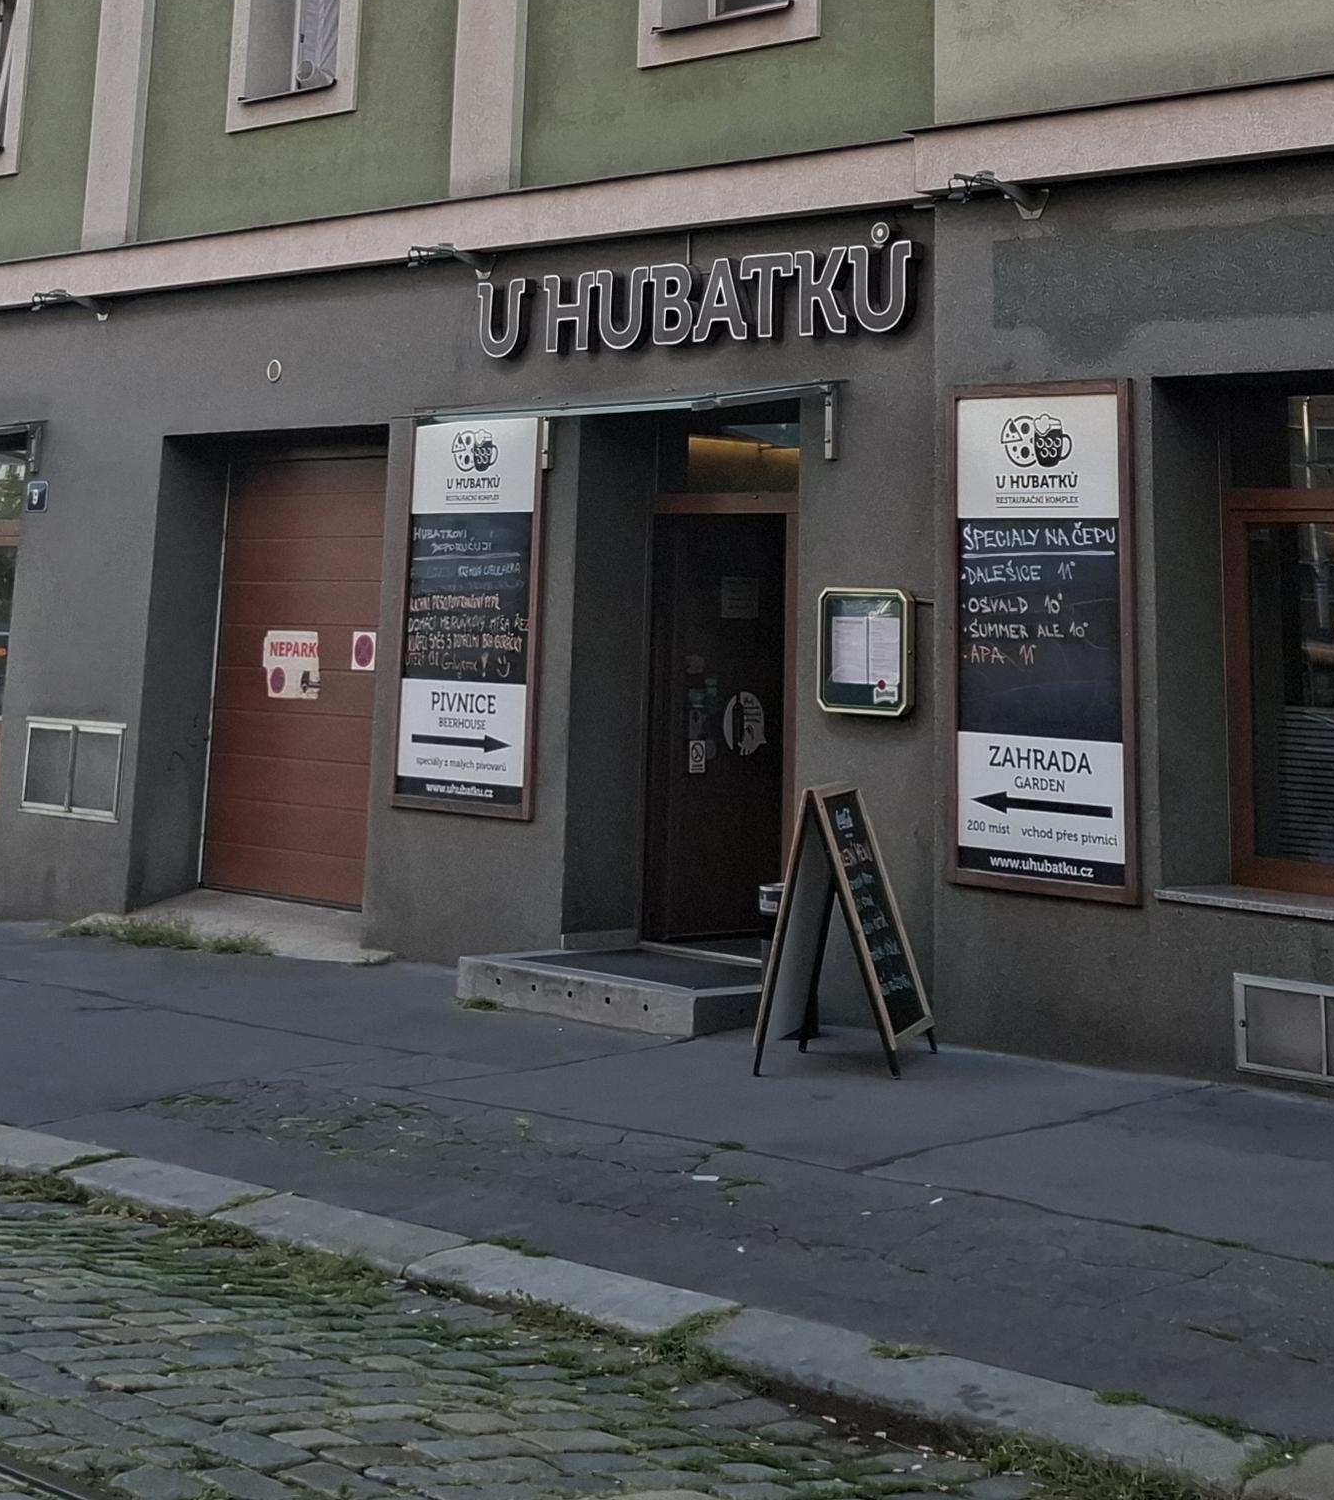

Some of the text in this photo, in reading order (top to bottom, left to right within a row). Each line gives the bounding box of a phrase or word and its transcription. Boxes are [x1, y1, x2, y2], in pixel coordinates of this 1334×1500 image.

[476, 221, 917, 359] U HUBATKŮ
[447, 474, 501, 490] U HUBATKŮ
[995, 471, 1078, 489] U HUBATKŮ
[1045, 527, 1070, 547] NA
[1072, 521, 1116, 546] ČEPU
[1037, 623, 1065, 638] ALE
[970, 645, 1005, 664] APA
[431, 691, 497, 715] PIVNICE
[438, 716, 487, 731] BEERHOUSE
[988, 745, 1093, 775] ZAHRADA
[1014, 776, 1066, 793] GARDEN
[967, 819, 1118, 847] 200 míst vchod přes pivnici
[989, 855, 1095, 879] www.uhubatku.cz
